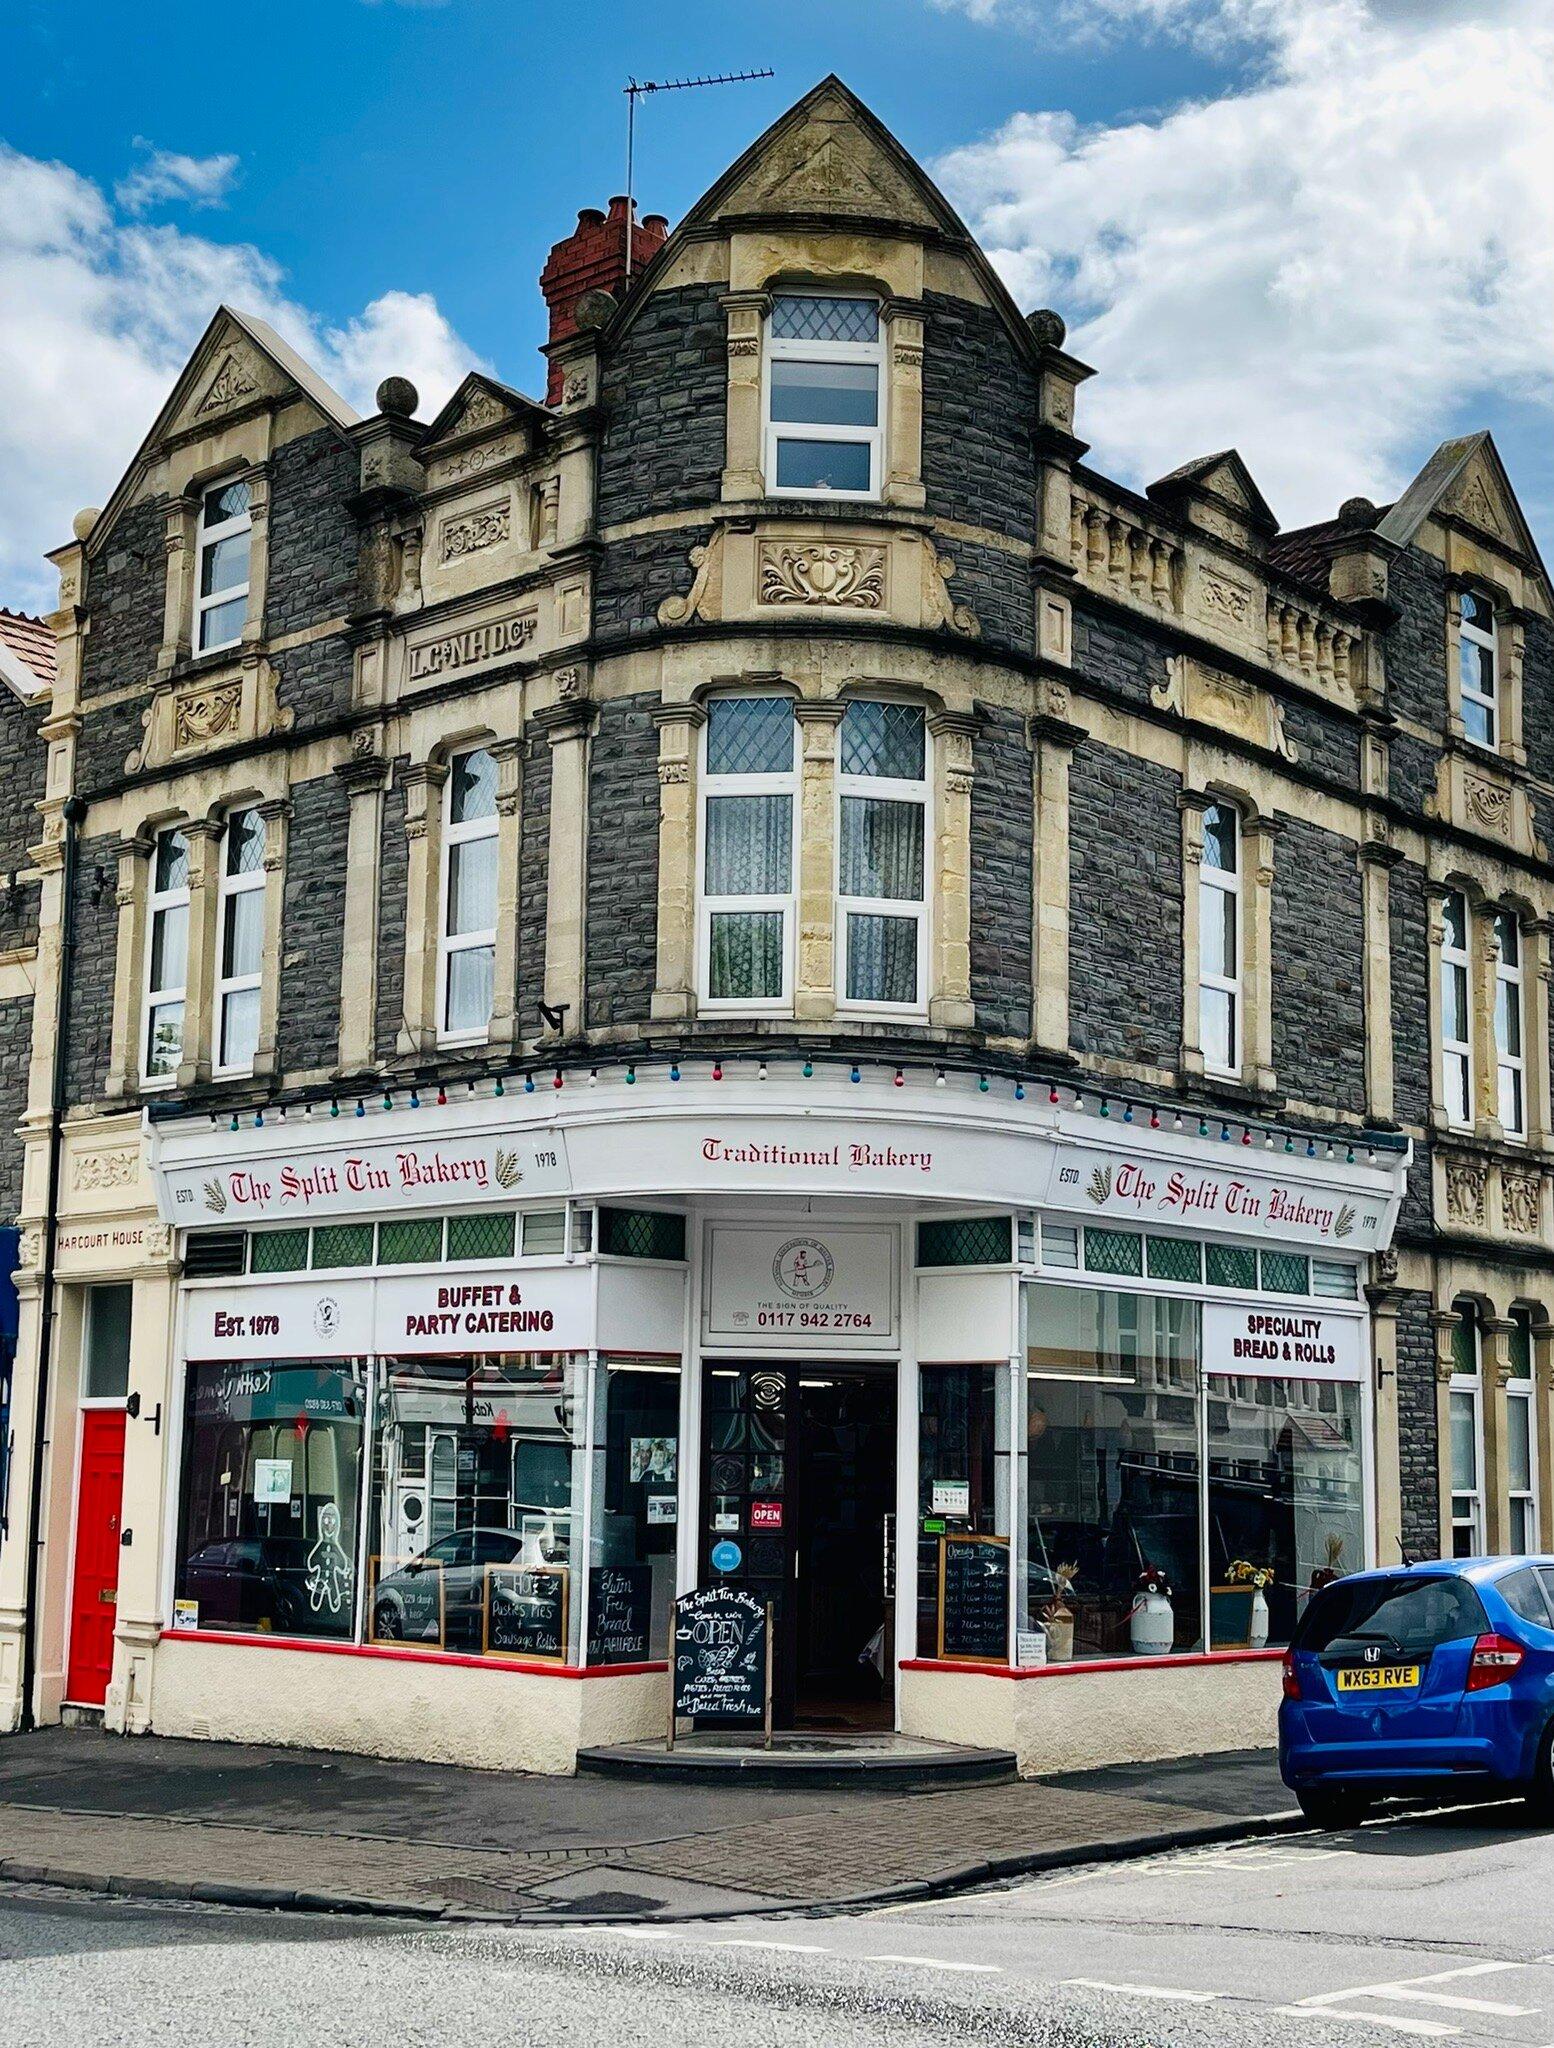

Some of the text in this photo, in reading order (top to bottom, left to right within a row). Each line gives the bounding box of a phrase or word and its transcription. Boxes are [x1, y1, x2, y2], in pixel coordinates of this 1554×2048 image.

[535, 1152, 557, 1167] 1978
[702, 1138, 932, 1173] Traditional Bakery
[229, 1152, 489, 1209] The Split Tin Bakery
[1116, 1163, 1334, 1236] The Split Tin Bakery
[1363, 1215, 1378, 1230] 1978
[58, 1231, 143, 1250] HARCOURT HOUSE
[438, 1284, 521, 1308] BUFFET &
[249, 1316, 280, 1336] 1978
[406, 1310, 554, 1335] PARTY CATERING
[758, 1312, 872, 1327] 0117 942 2764
[1247, 1315, 1321, 1339] SPECIALITY
[1233, 1338, 1335, 1364] BREAD & ROLLS
[754, 1510, 780, 1520] OPEN
[677, 1587, 765, 1618] The Split Tin Bakery
[495, 1626, 533, 1651] Sausage
[693, 1620, 744, 1645] OPEN
[1344, 1668, 1413, 1687] WX63 RVE
[721, 1698, 746, 1712] Fresh
